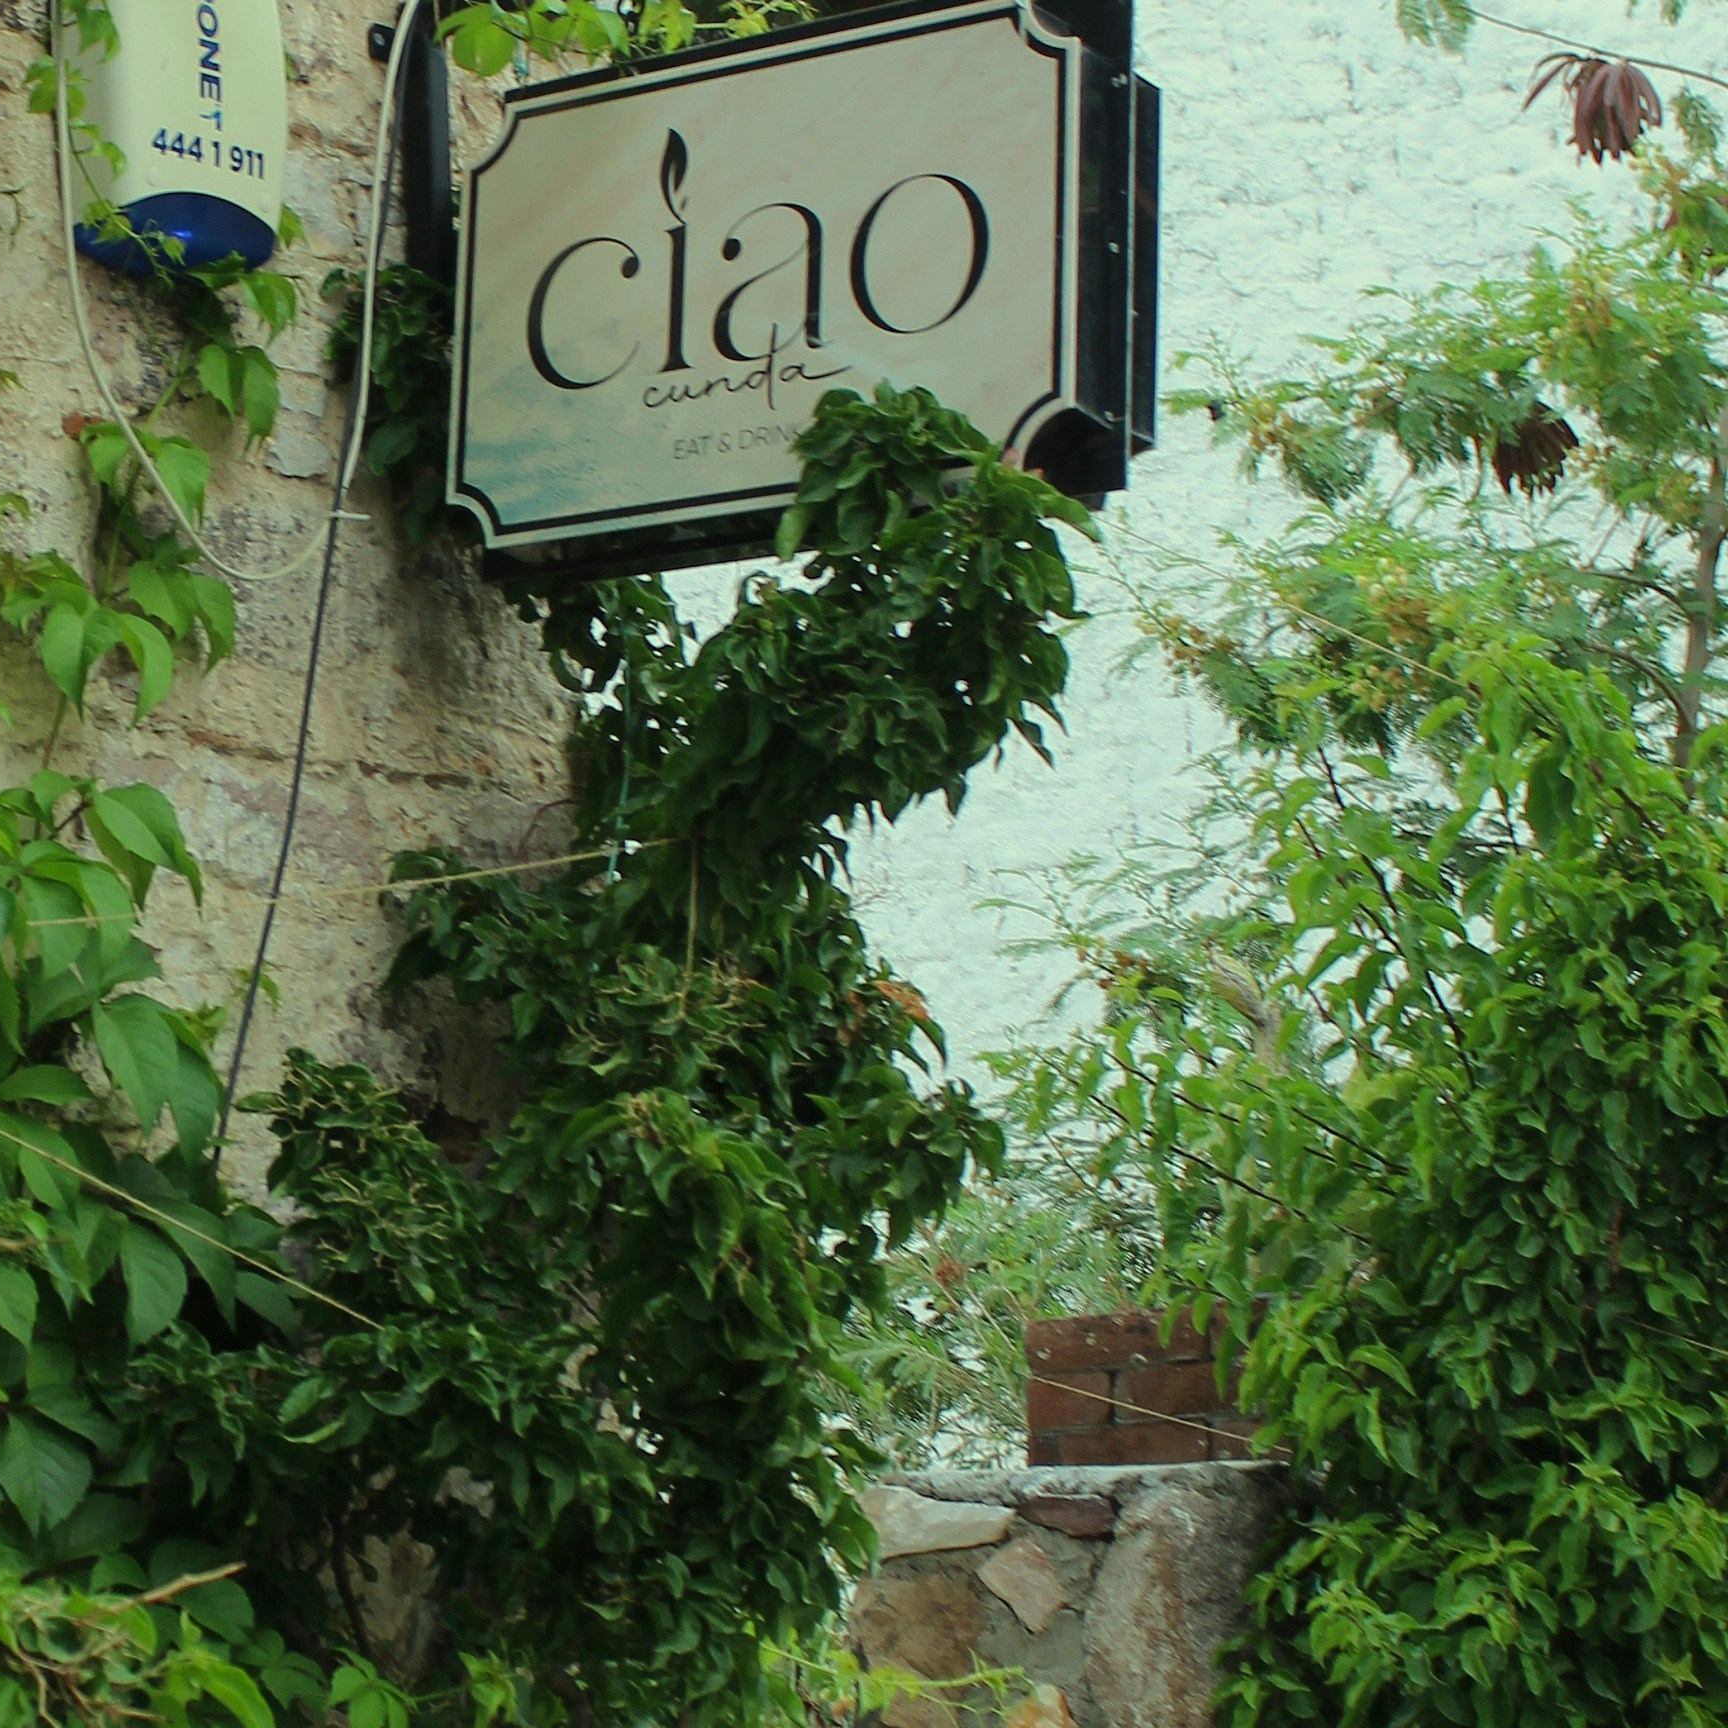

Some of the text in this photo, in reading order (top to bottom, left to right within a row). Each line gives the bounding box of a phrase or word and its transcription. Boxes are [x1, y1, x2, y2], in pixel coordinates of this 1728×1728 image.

[152, 127, 265, 180] 444 1 911
[526, 127, 990, 390] ciao
[643, 322, 855, 411] cunda
[673, 432, 713, 460] EAT
[716, 431, 733, 454] &
